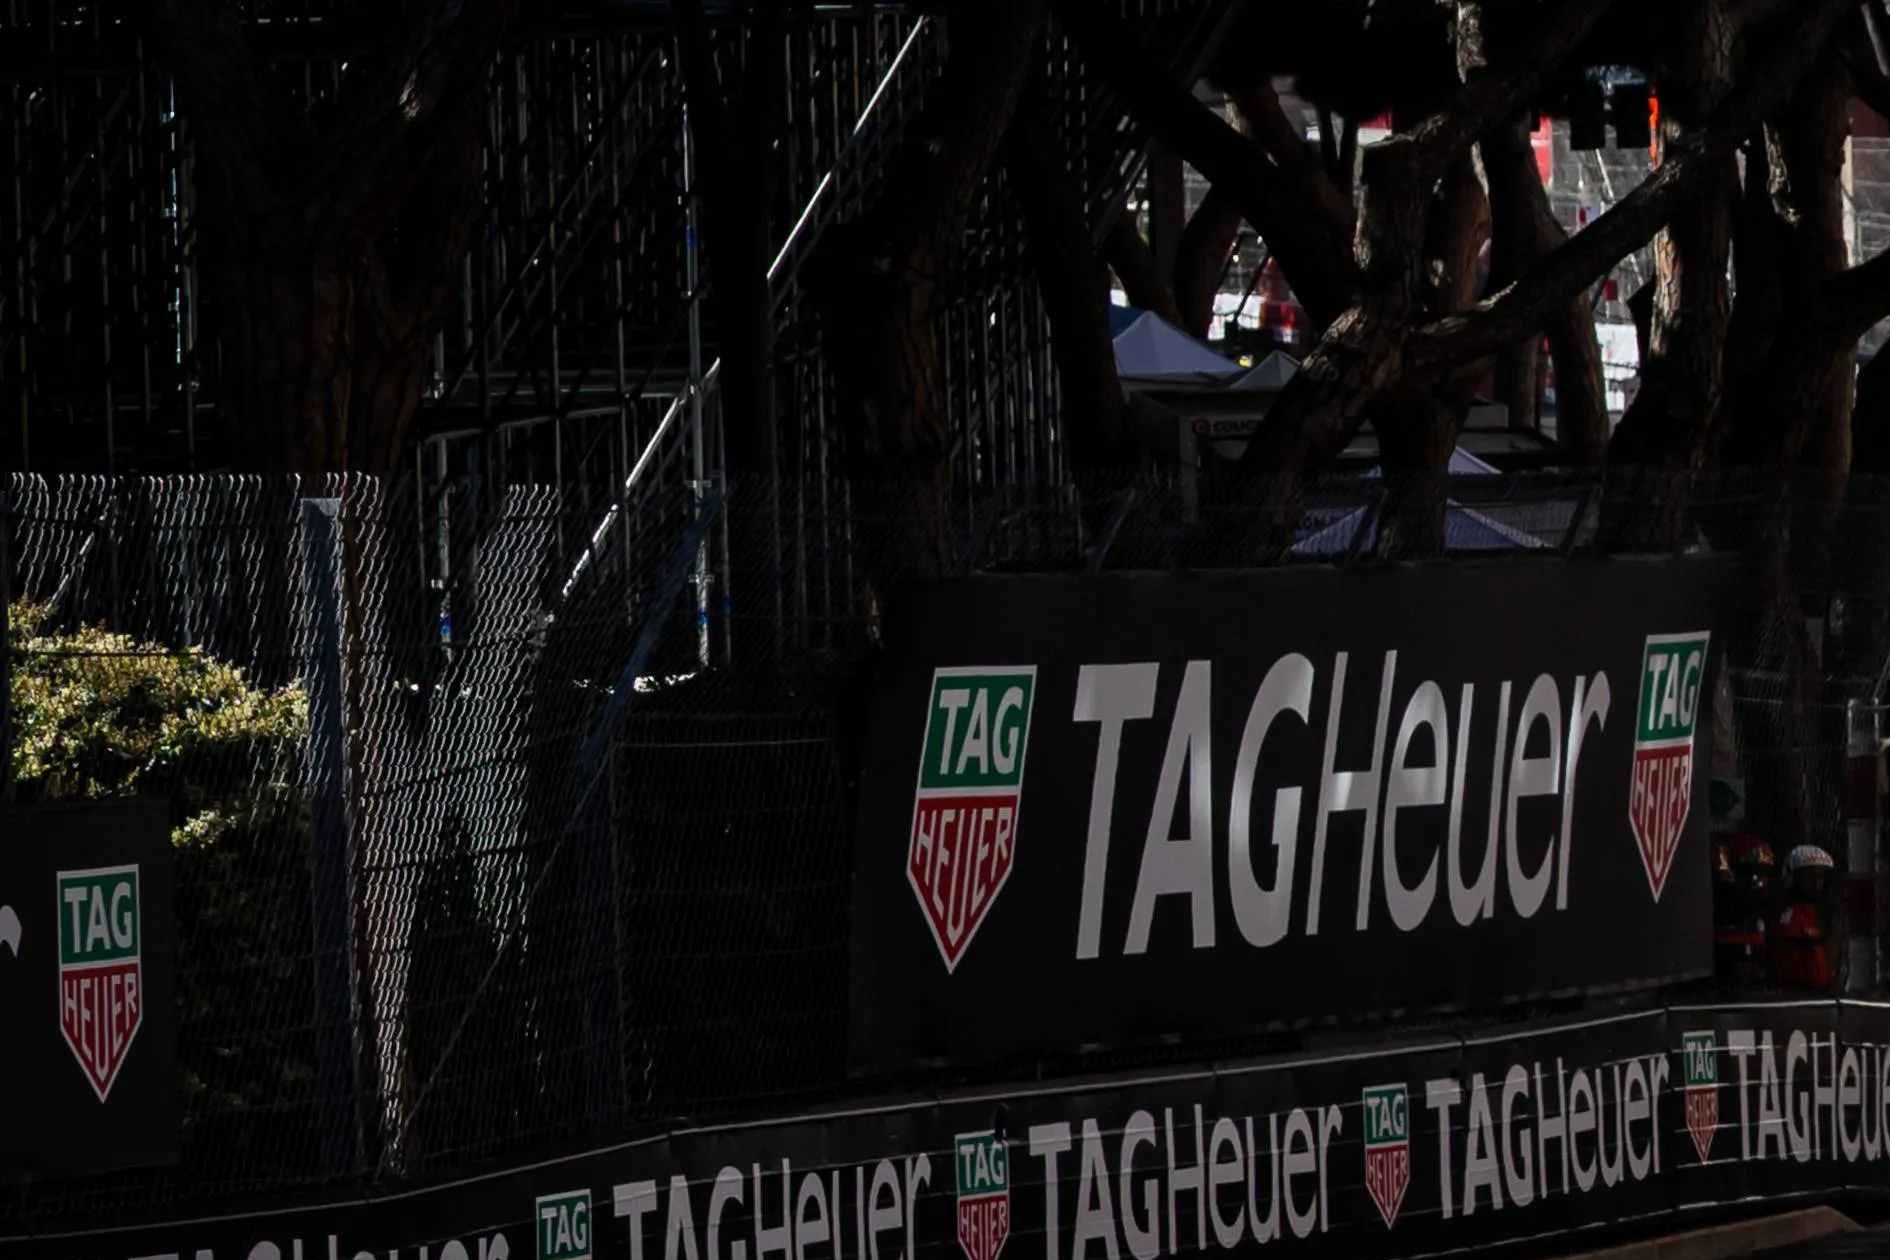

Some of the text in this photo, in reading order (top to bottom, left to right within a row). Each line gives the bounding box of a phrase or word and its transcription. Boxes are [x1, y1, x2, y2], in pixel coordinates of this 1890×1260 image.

[938, 686, 1024, 776] TAG
[1648, 649, 1700, 732] TAG
[1072, 650, 1612, 959] TAGHeuer
[1632, 755, 1690, 885] HEUER
[64, 881, 133, 953] TAG
[915, 805, 1013, 948] HEUER
[62, 970, 138, 1085] HEUER
[1686, 1039, 1714, 1081] TAG
[1367, 1090, 1407, 1137] TAG
[1425, 1054, 1671, 1220] TAGHeuer
[960, 1143, 1006, 1190] TAG
[1366, 1145, 1409, 1215] HEUER
[541, 1199, 587, 1254] TAG
